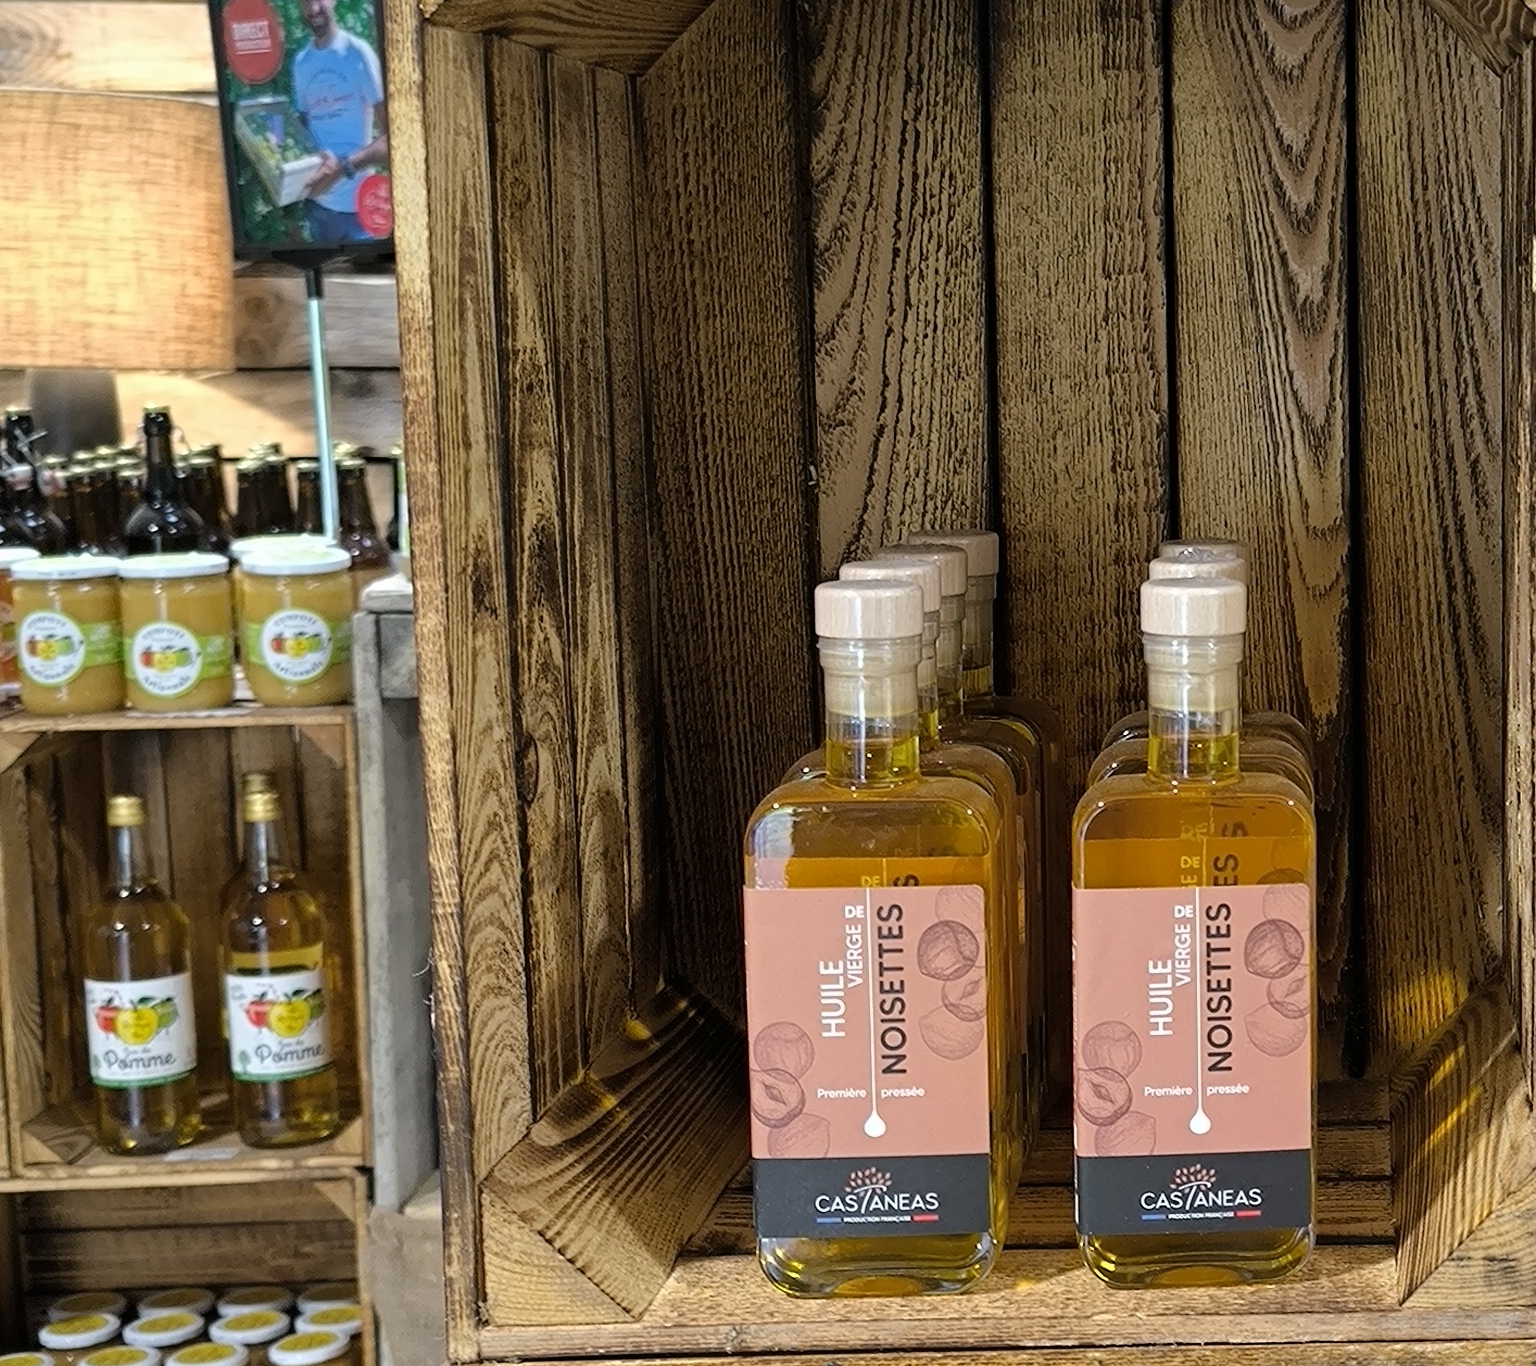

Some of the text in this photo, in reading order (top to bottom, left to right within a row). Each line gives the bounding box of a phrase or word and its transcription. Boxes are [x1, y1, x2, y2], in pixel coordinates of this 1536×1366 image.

[844, 905, 865, 988] VIERGE DE
[819, 960, 846, 1037] HUILE
[877, 903, 908, 1075] NOISETTES
[1149, 959, 1173, 1037] HUILE
[1206, 902, 1233, 1073] NOISETTES
[103, 1048, 176, 1071] Pomme
[254, 1043, 325, 1066] Pomme
[817, 1086, 925, 1100] Première pressée
[815, 1184, 939, 1214] CASTANEAS
[1140, 1181, 1262, 1211] CASTANEAS
